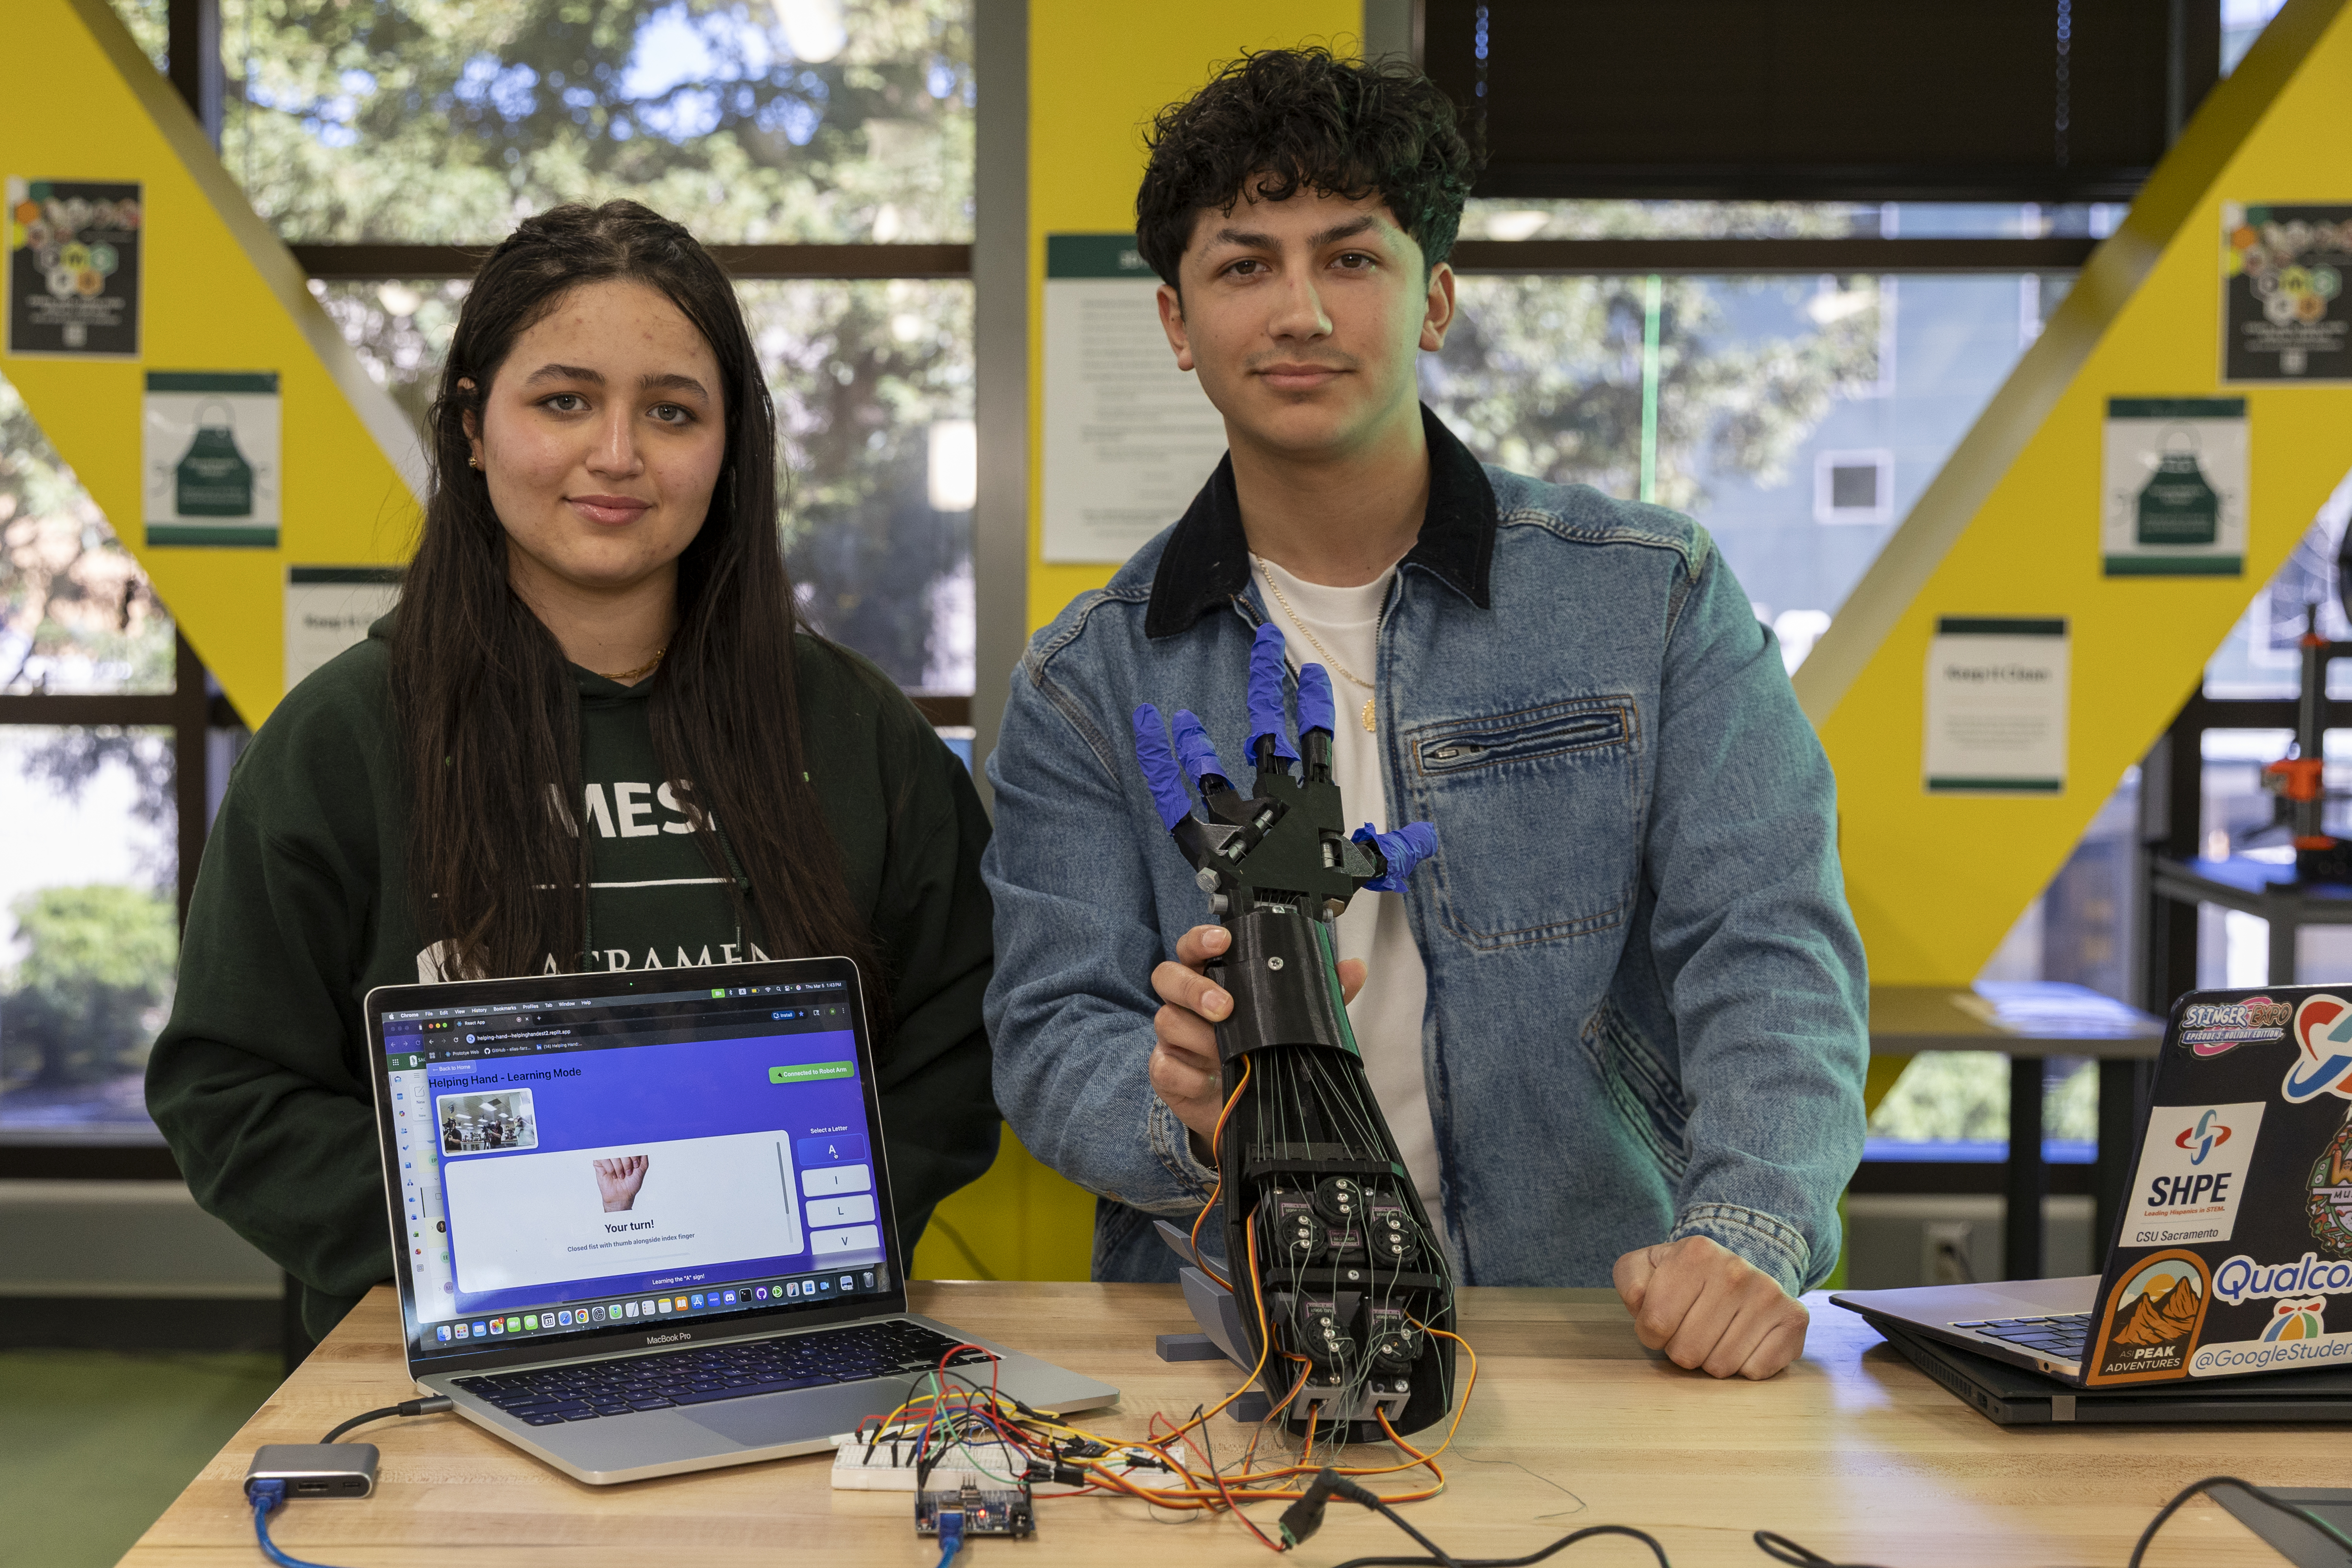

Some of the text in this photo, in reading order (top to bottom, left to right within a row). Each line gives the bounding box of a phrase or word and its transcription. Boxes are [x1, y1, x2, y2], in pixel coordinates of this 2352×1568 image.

[2183, 1003, 2292, 1028] STINGER EXPO
[2186, 1032, 2216, 1040] EPISODE
[2224, 1030, 2252, 1040] HOLIDAY
[2252, 1029, 2279, 1038] EDITION
[429, 1076, 469, 1089] Helping
[471, 1072, 498, 1085] Hand
[508, 1069, 553, 1083] Learning
[554, 1067, 582, 1078] Mode
[783, 1069, 812, 1078] Connected
[829, 1144, 836, 1154] A
[2148, 1173, 2232, 1207] SHPE
[2334, 1190, 2352, 1199] MU
[838, 1207, 844, 1215] L
[604, 1219, 655, 1233] Your turn!
[567, 1244, 588, 1252] Closed
[613, 1239, 632, 1248] thumb
[633, 1236, 661, 1246] alongside
[678, 1232, 695, 1241] finger
[841, 1236, 848, 1246] V
[2136, 1229, 2218, 1242] CSU Sacramento
[2217, 1256, 2352, 1299] Qualco
[646, 1332, 691, 1345] MacBook Pro
[2134, 1346, 2176, 1360] PEAK
[2105, 1358, 2181, 1373] ADVENTURES
